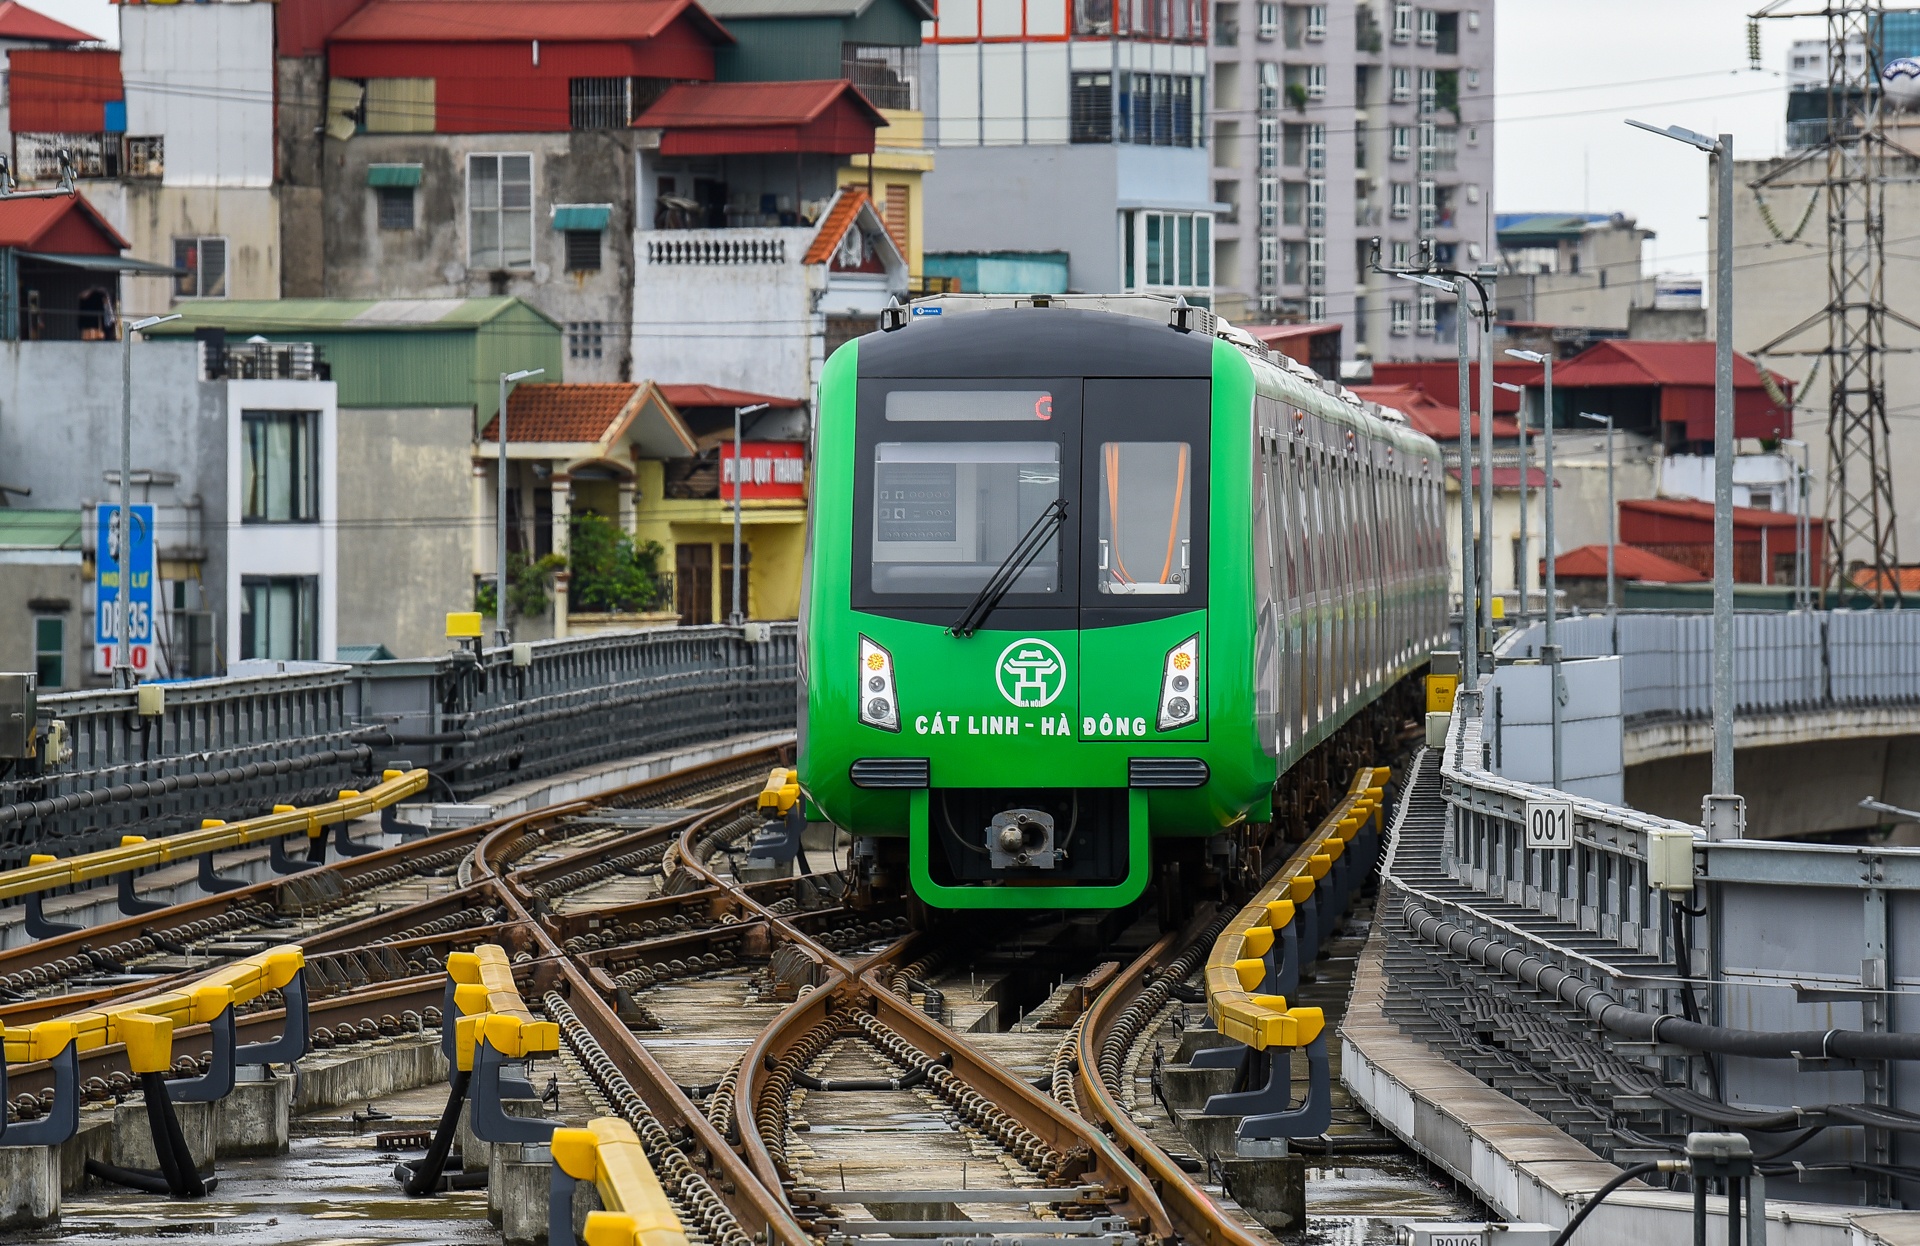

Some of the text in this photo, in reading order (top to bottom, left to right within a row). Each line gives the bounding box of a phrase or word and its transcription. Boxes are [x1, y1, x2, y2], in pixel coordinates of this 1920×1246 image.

[101, 645, 148, 670] 10
[915, 712, 960, 734] CÁT
[968, 716, 1019, 734] LINH
[1041, 713, 1070, 736] HÀ
[1083, 713, 1146, 736] ĐÔNG
[1533, 809, 1566, 840] 001
